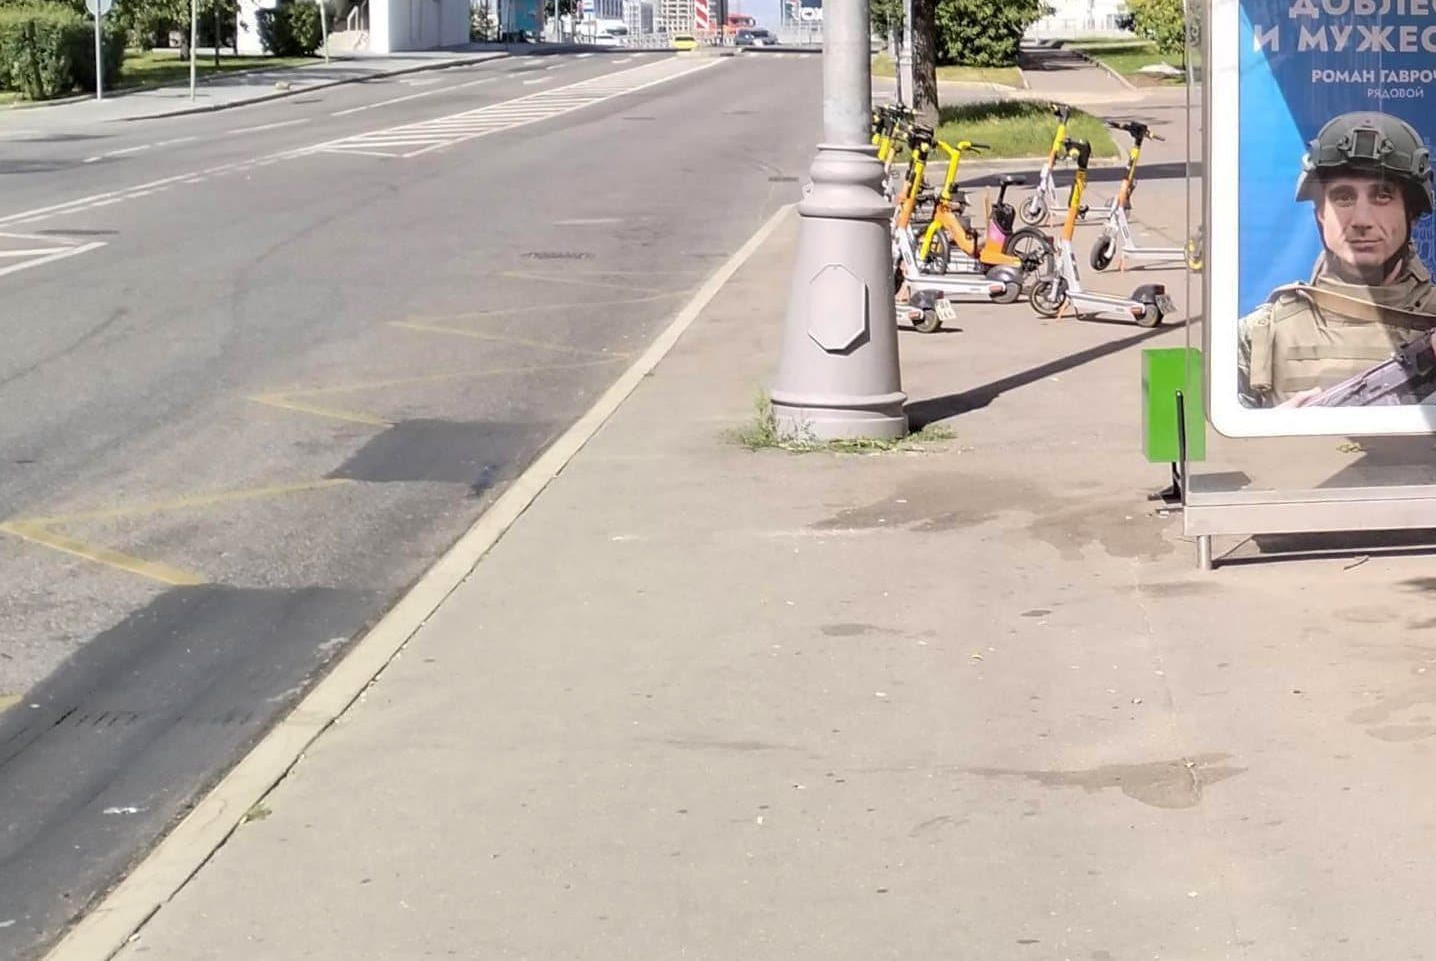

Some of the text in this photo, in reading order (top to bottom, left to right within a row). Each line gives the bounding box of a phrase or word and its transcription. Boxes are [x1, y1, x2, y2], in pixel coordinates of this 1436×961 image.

[1254, 25, 1279, 52] И
[1311, 70, 1375, 84] РОМАН
[1366, 86, 1425, 99] РЯДОВОЙ
